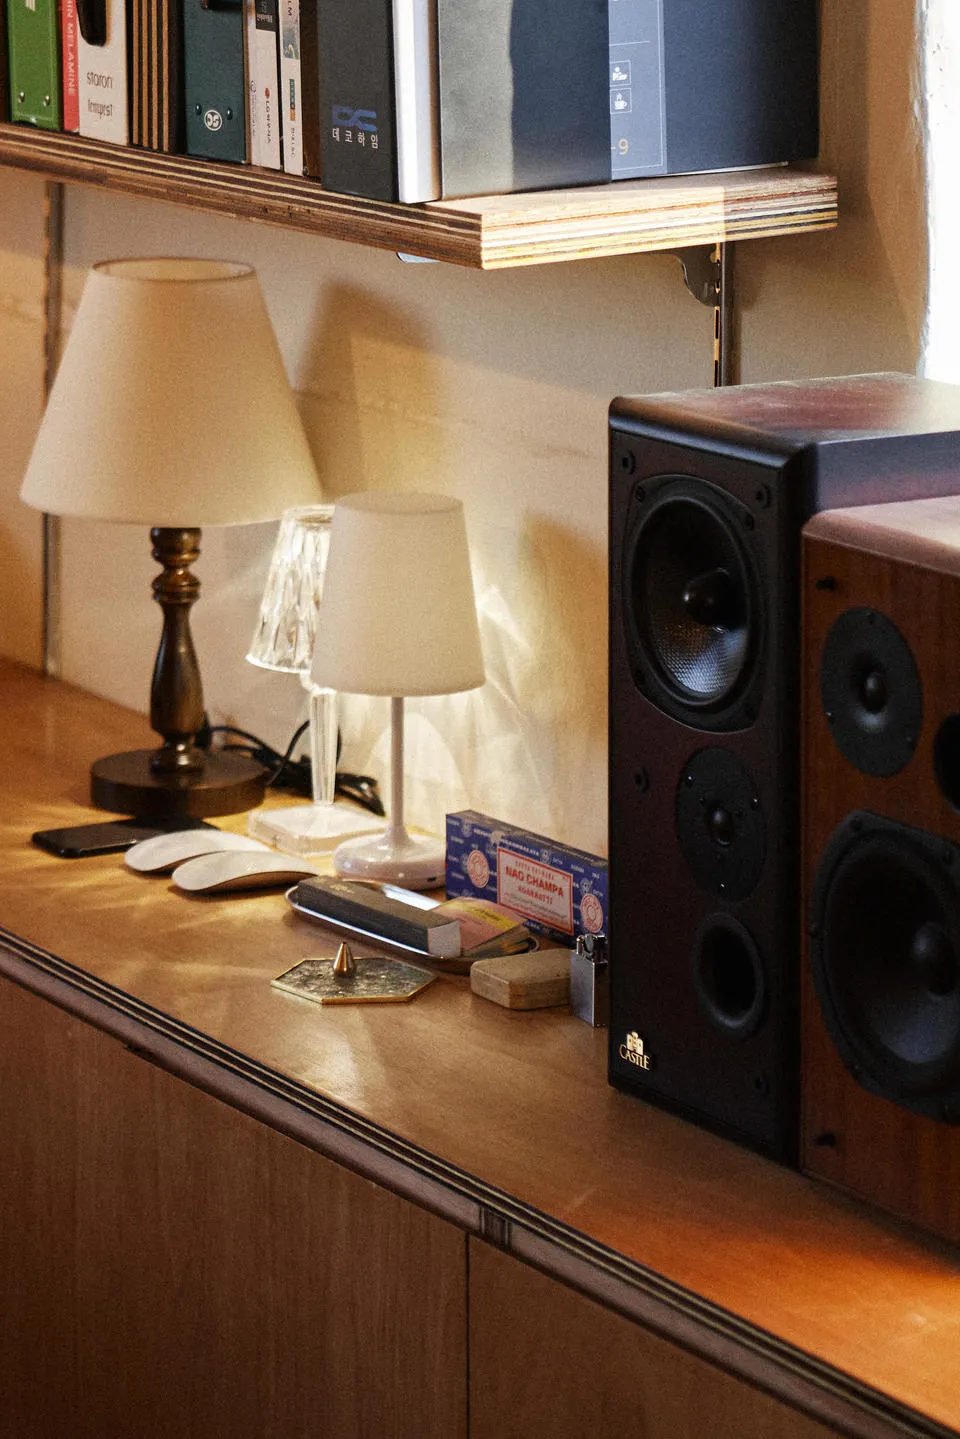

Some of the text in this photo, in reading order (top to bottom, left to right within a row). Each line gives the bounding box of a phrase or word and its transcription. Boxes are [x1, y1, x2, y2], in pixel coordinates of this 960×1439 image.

[505, 866, 564, 897] NAG CHAMPA
[619, 1044, 650, 1071] CASTLE
